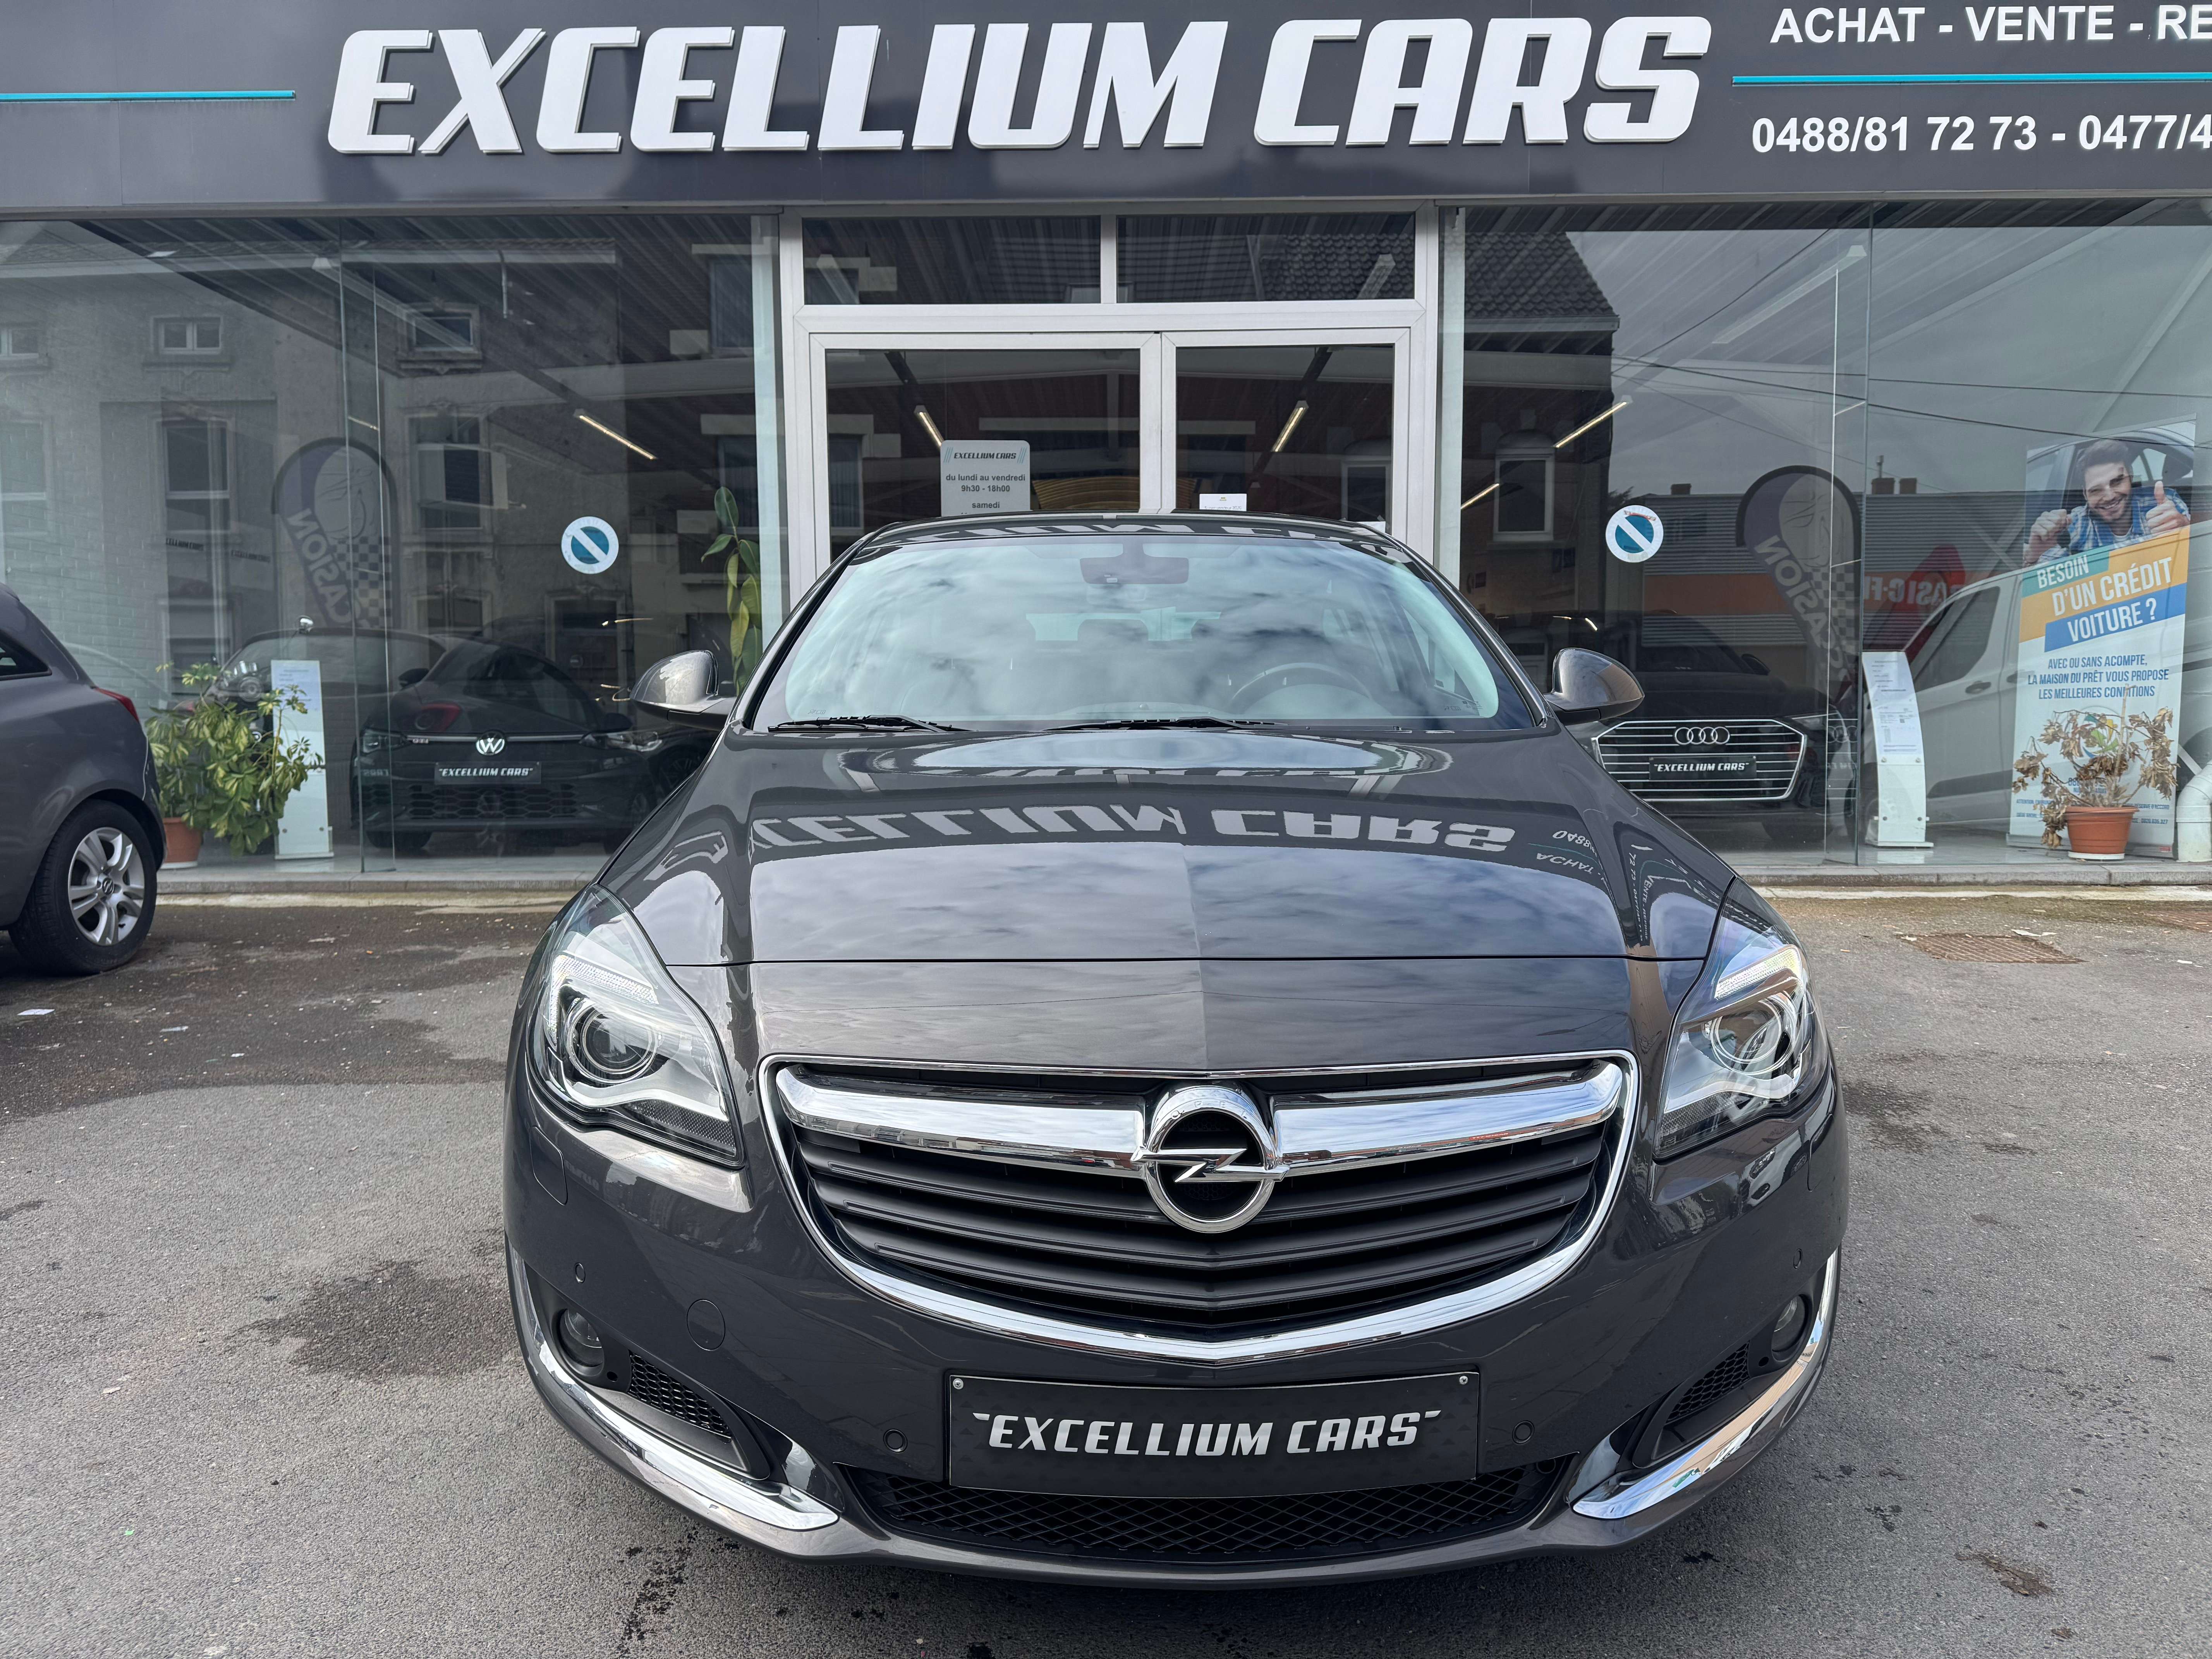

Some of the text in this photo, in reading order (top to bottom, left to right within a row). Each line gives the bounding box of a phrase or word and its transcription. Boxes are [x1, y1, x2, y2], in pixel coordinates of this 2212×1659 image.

[1770, 7, 1925, 43] ACHAT
[1965, 5, 2113, 42] VENTE
[2130, 22, 2143, 31] -
[2157, 4, 2212, 40] RE
[328, 16, 1712, 154] EXCELLIUM CARS
[1752, 113, 2212, 153] 0488/81 72 73 - 0477/4
[2037, 555, 2089, 589] BESOIN
[2052, 557, 2173, 616] D'UN CRÉDIT
[2067, 598, 2157, 642] VOITURE ?
[2028, 669, 2169, 685] LA MAISON DU PRÊT VOUS PROPOSE
[2048, 654, 2147, 669] AVEC OU SANS ACOMPTE,
[2039, 689, 2052, 699] LES
[2054, 687, 2102, 699] MEILLEURES
[442, 768, 529, 776] EXCELLIUM CARS
[1657, 763, 1745, 772] EXCELLIUM CARS
[989, 1412, 1424, 1456] EXCELLIUM CARS
